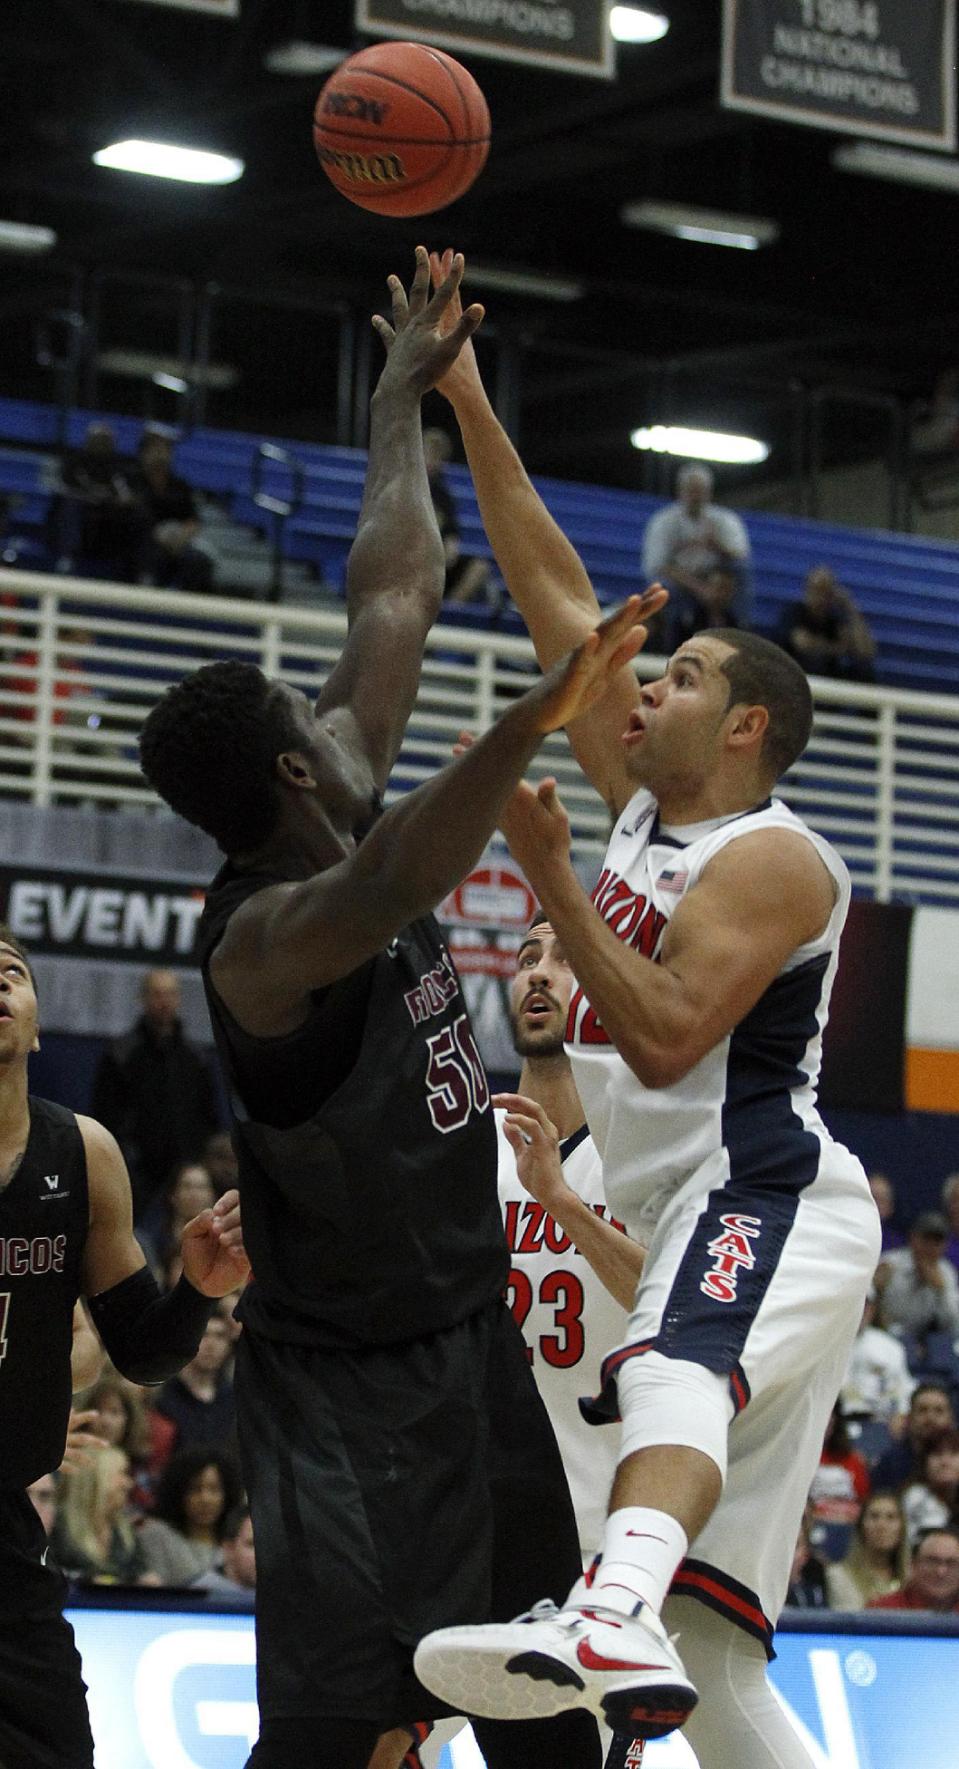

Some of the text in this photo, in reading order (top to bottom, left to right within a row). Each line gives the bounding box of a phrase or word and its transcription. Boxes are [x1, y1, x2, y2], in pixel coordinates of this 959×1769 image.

[760, 55, 920, 115] CHAMPIONS
[773, 24, 907, 78] NATIONAL
[9, 879, 206, 955] EVENT
[425, 1014, 490, 1134] 50
[701, 1213, 762, 1302] CATS
[501, 1268, 585, 1369] 23
